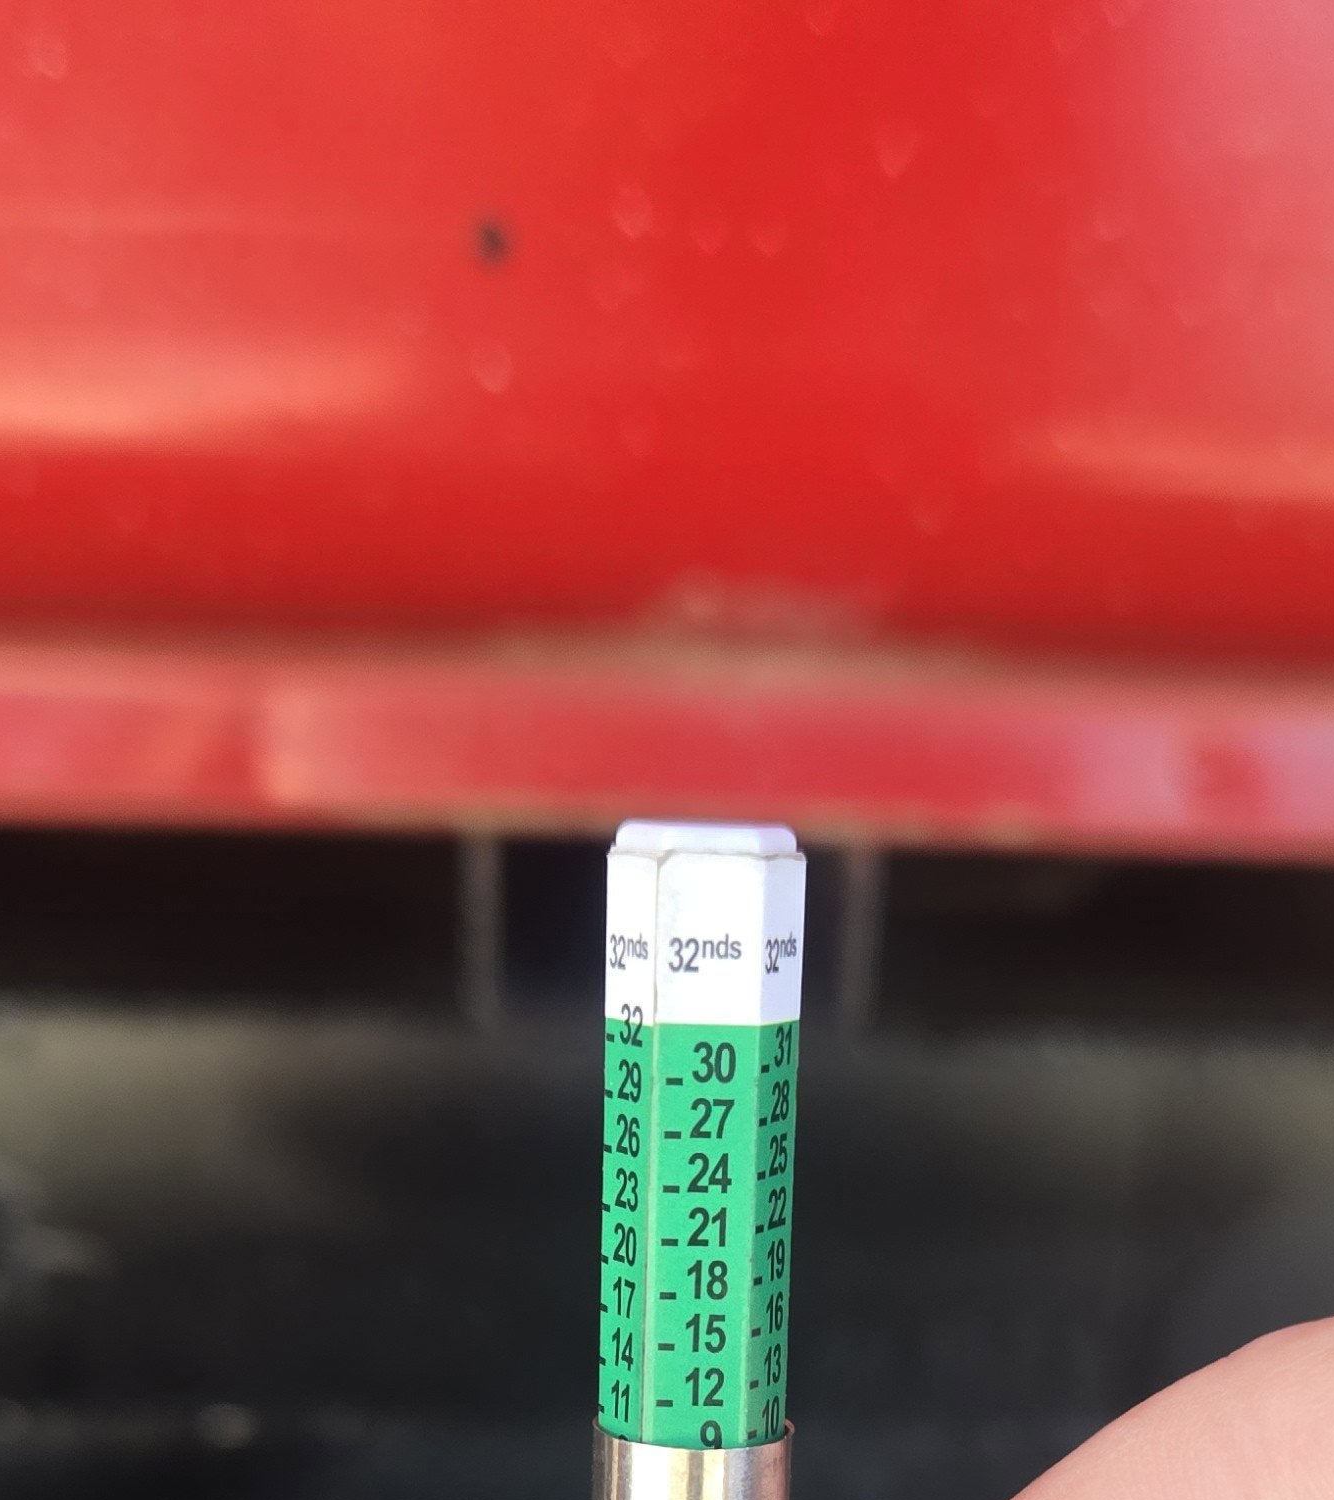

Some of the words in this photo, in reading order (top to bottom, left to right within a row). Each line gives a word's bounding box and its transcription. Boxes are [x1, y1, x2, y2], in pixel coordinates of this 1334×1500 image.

[610, 934, 648, 970] 32nds
[668, 933, 742, 973] 32nds
[766, 932, 797, 973] 32nds
[620, 1004, 643, 1048] 32
[774, 1024, 792, 1067] 31
[617, 1059, 641, 1103] 29
[692, 1041, 736, 1084] 30
[690, 1098, 735, 1139] 27
[771, 1080, 790, 1124] 28
[616, 1114, 640, 1158] 26
[769, 1133, 788, 1177] 25
[615, 1168, 638, 1212] 23
[687, 1153, 732, 1193] 24
[687, 1207, 727, 1247] 21
[768, 1186, 786, 1230] 22
[613, 1224, 636, 1267] 20
[768, 1238, 785, 1281] 19
[613, 1276, 636, 1318] 17
[687, 1260, 728, 1300] 18
[686, 1313, 726, 1354] 15
[766, 1292, 783, 1333] 16
[612, 1328, 633, 1371] 14
[764, 1344, 781, 1386] 13
[611, 1380, 630, 1423] 11
[685, 1367, 725, 1406] 12
[762, 1396, 779, 1439] 10
